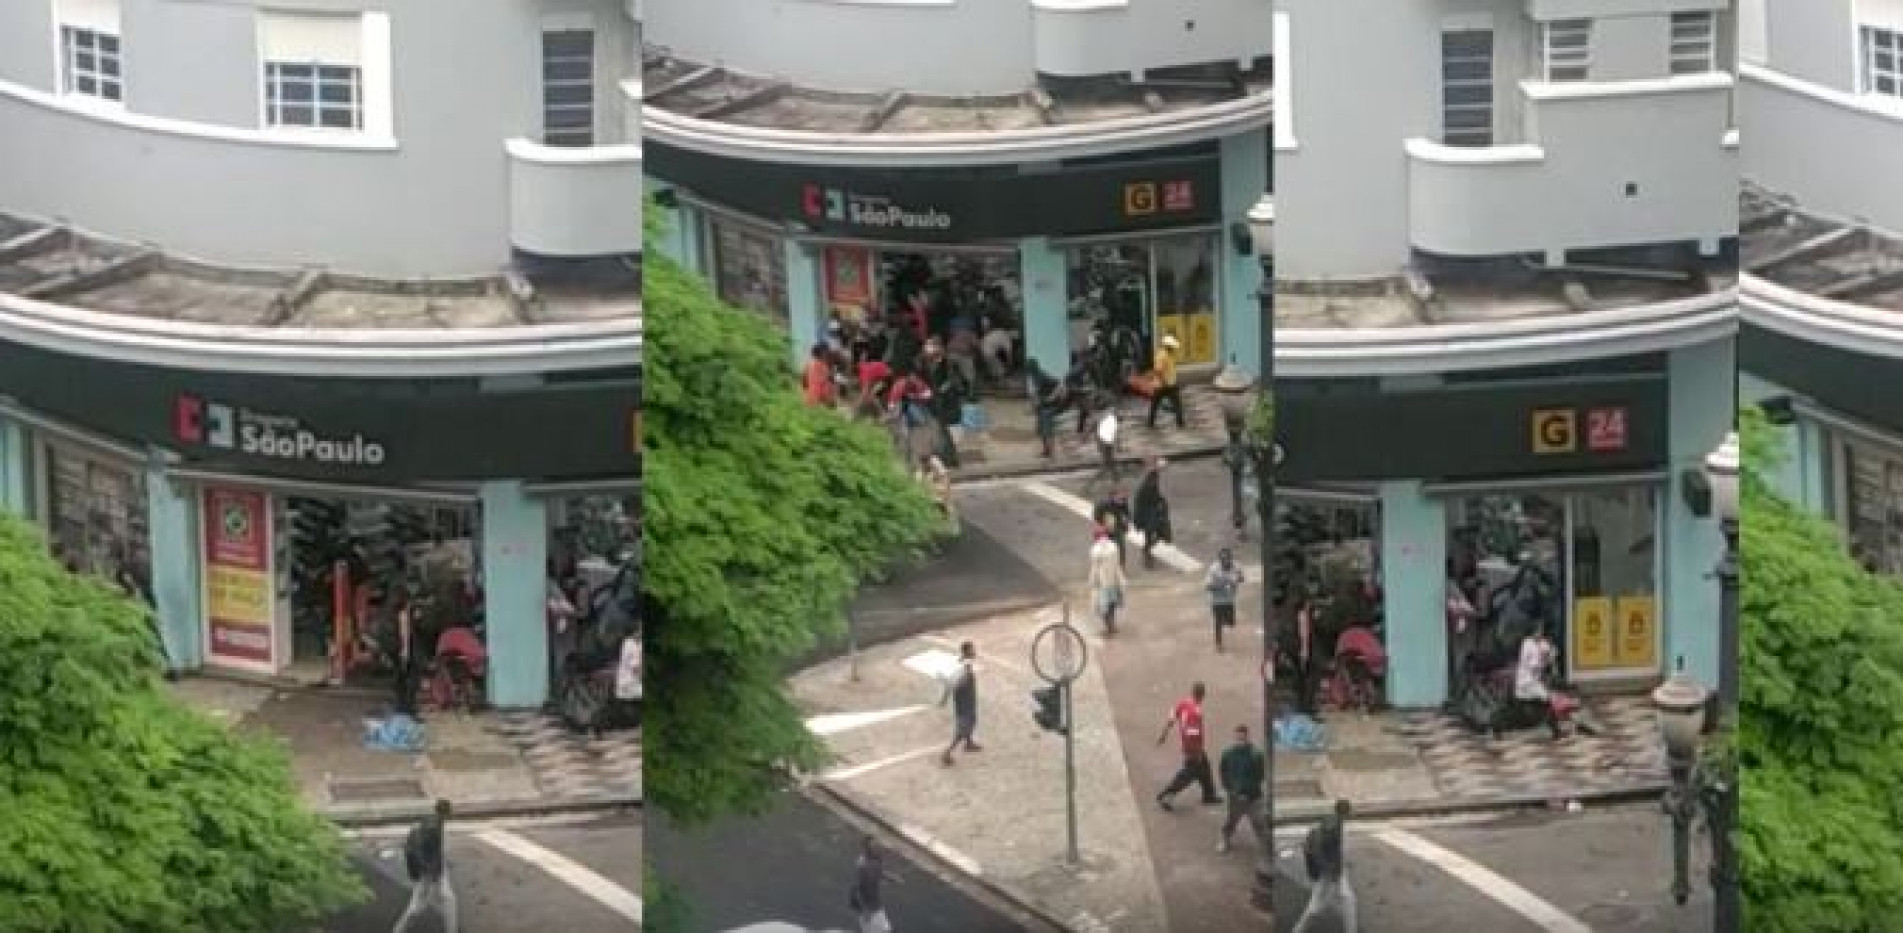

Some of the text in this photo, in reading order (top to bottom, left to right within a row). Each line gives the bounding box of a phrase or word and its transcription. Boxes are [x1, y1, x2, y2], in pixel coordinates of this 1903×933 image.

[1130, 188, 1152, 210] G
[1540, 415, 1569, 447] G
[1588, 410, 1624, 438] 24
